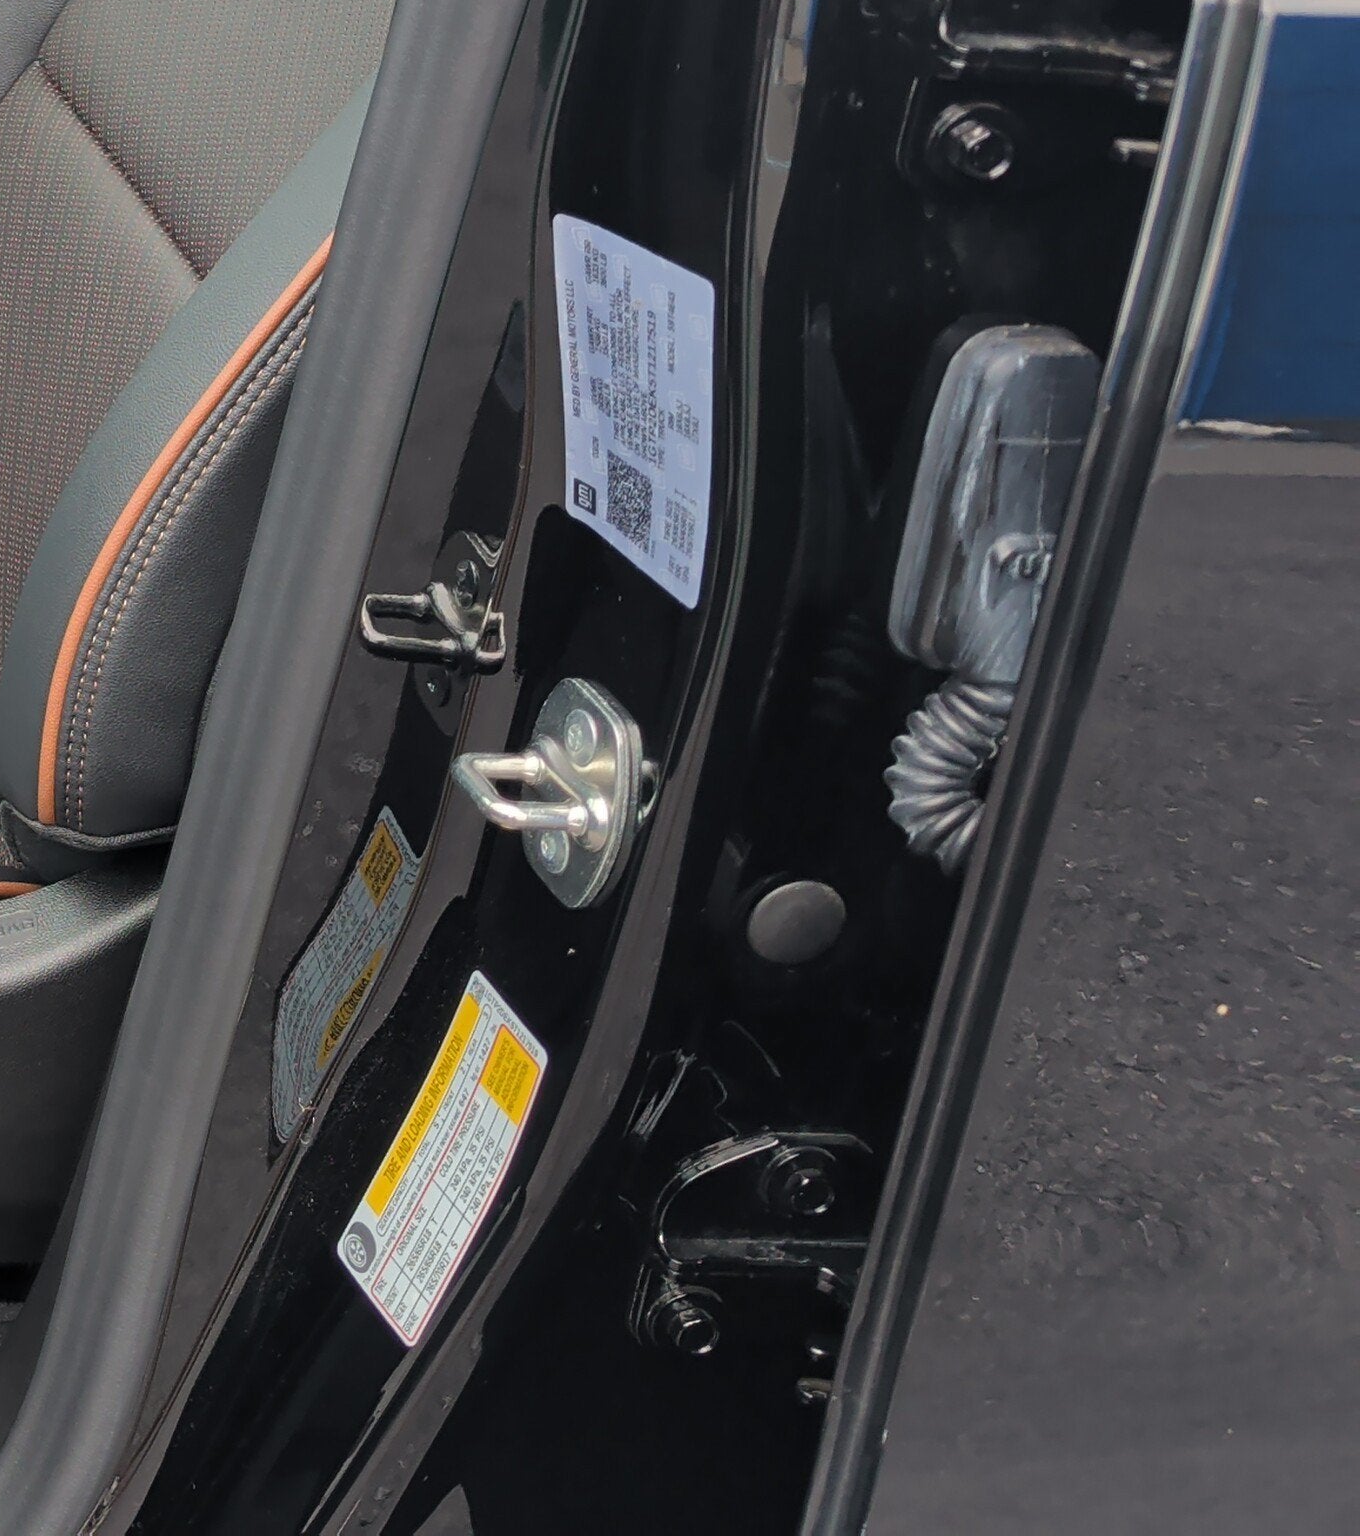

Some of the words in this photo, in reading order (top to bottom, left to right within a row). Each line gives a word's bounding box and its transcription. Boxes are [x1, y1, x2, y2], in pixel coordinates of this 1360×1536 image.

[564, 276, 574, 300] LLC
[565, 296, 576, 340] MOTORS
[567, 335, 579, 384] GENERAL
[571, 382, 580, 399] BY
[578, 483, 593, 510] gm
[476, 1035, 493, 1063] 1427
[383, 1155, 401, 1185] TIRE
[394, 1133, 413, 1163] AND
[405, 1092, 434, 1143] LOADING
[426, 1030, 465, 1101] INFORMATION
[437, 1152, 454, 1180] COLD
[457, 1098, 481, 1142] PRESSURE
[394, 1217, 418, 1259] ORIGINAL
